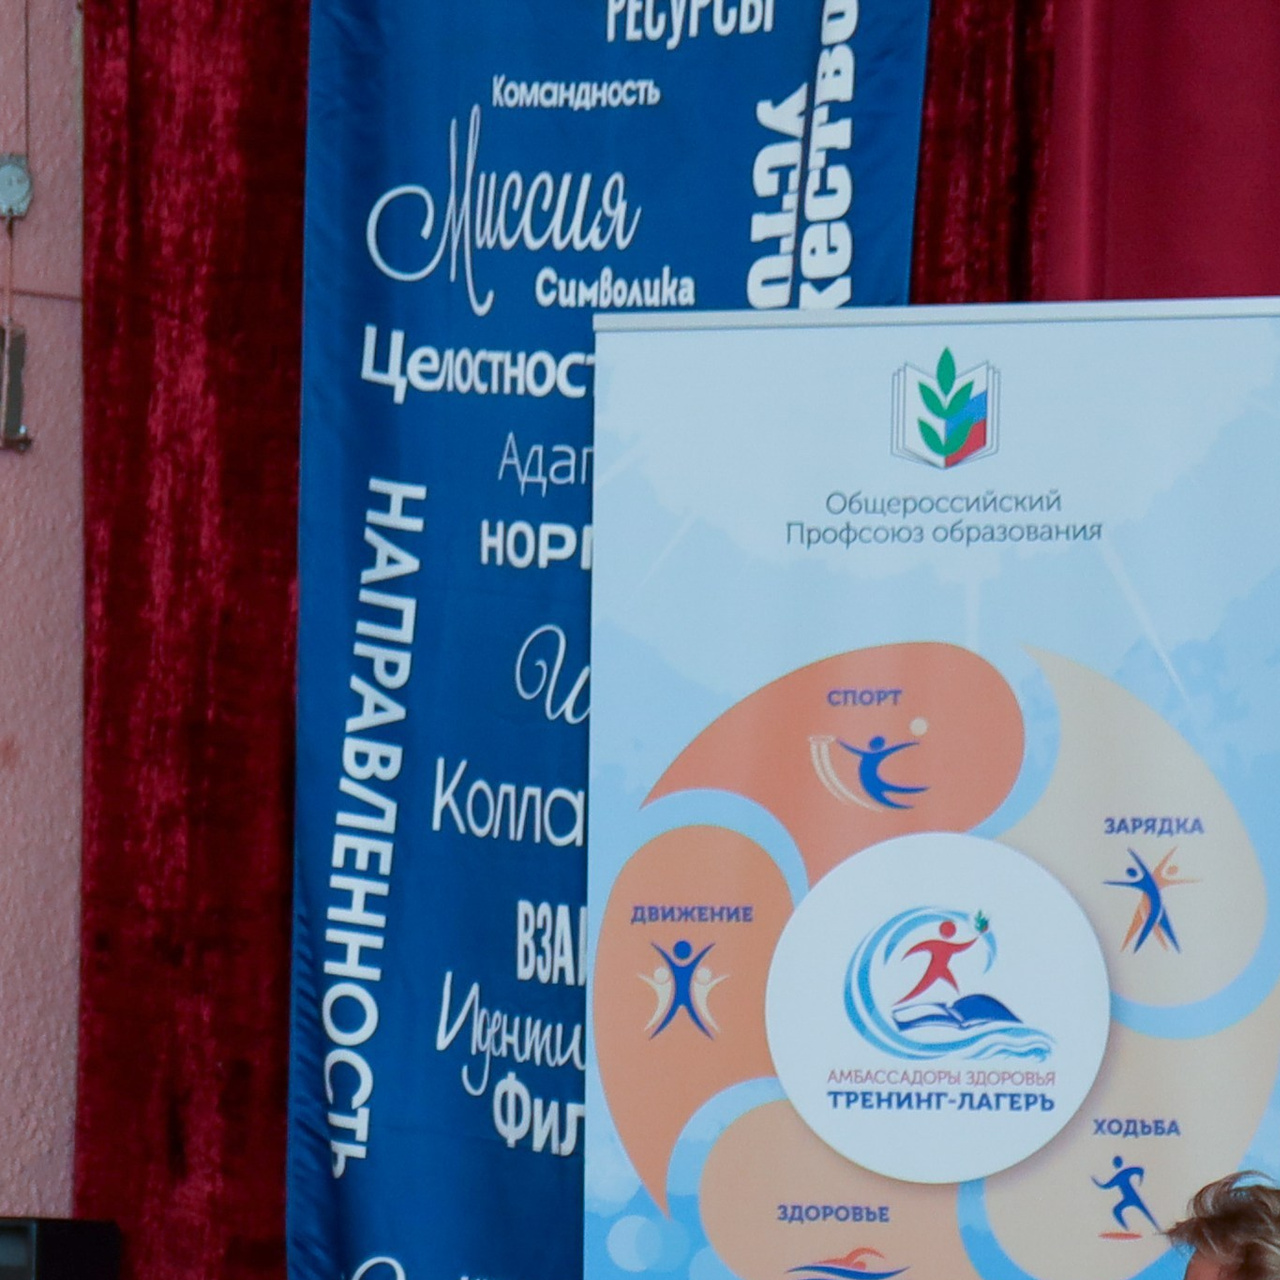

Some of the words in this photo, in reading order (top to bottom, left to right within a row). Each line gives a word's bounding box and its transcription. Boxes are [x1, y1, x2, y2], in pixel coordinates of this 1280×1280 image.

[492, 74, 661, 111] Командность
[366, 103, 642, 317] Миссия
[535, 265, 696, 308] Символика
[361, 324, 596, 404] Целостнос
[825, 489, 1063, 519] Общероссийский
[785, 520, 925, 550] Профсоюз
[931, 519, 1104, 547] образования
[827, 689, 903, 707] СПОРТ
[431, 756, 585, 847] Колла
[322, 475, 428, 1179] НАПРАВЛЕННОСТЬ
[1104, 817, 1205, 838] ЗАРЯДКА
[631, 905, 754, 925] ДВИЖЕНИЕ
[827, 1068, 962, 1087] АМБАССАДОРЫ
[966, 1070, 1057, 1087] ЗДОРОВЬЯ
[827, 1090, 1057, 1113] ТРЕНИНГ-ЛАГЕРЬ
[1093, 1118, 1181, 1138] ХОДЬБА
[777, 1204, 890, 1224] ЗДОРОВЬЕ
